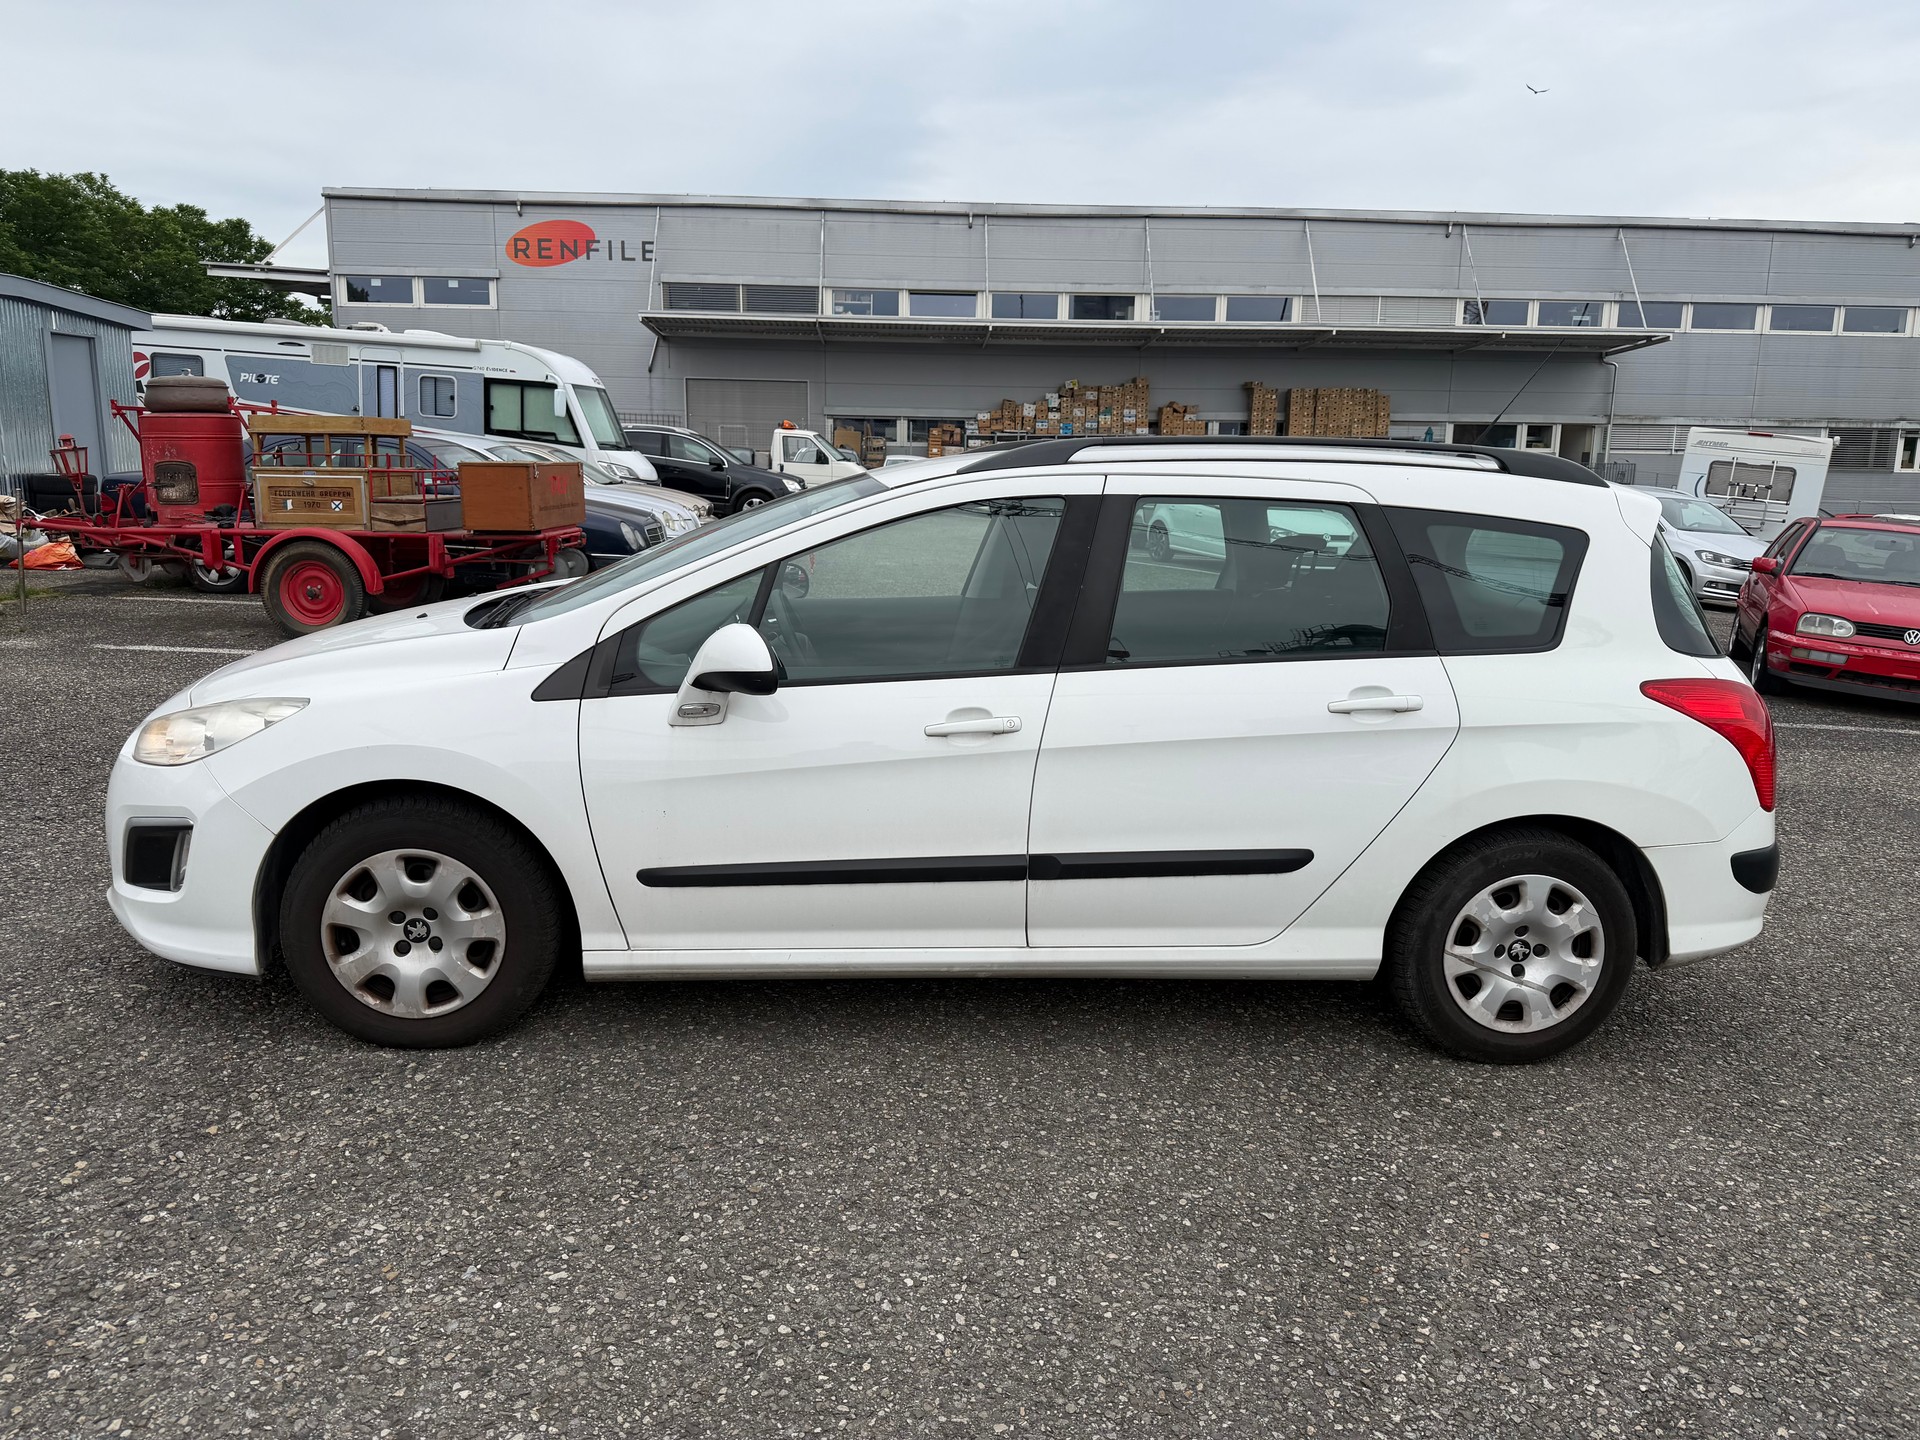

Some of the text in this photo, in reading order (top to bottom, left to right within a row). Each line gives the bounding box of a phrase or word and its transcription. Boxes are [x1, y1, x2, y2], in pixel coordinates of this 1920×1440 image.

[513, 237, 657, 262] RENFILE
[274, 489, 351, 498] FEUERWEHR GREPPEN
[303, 501, 321, 509] 1970
